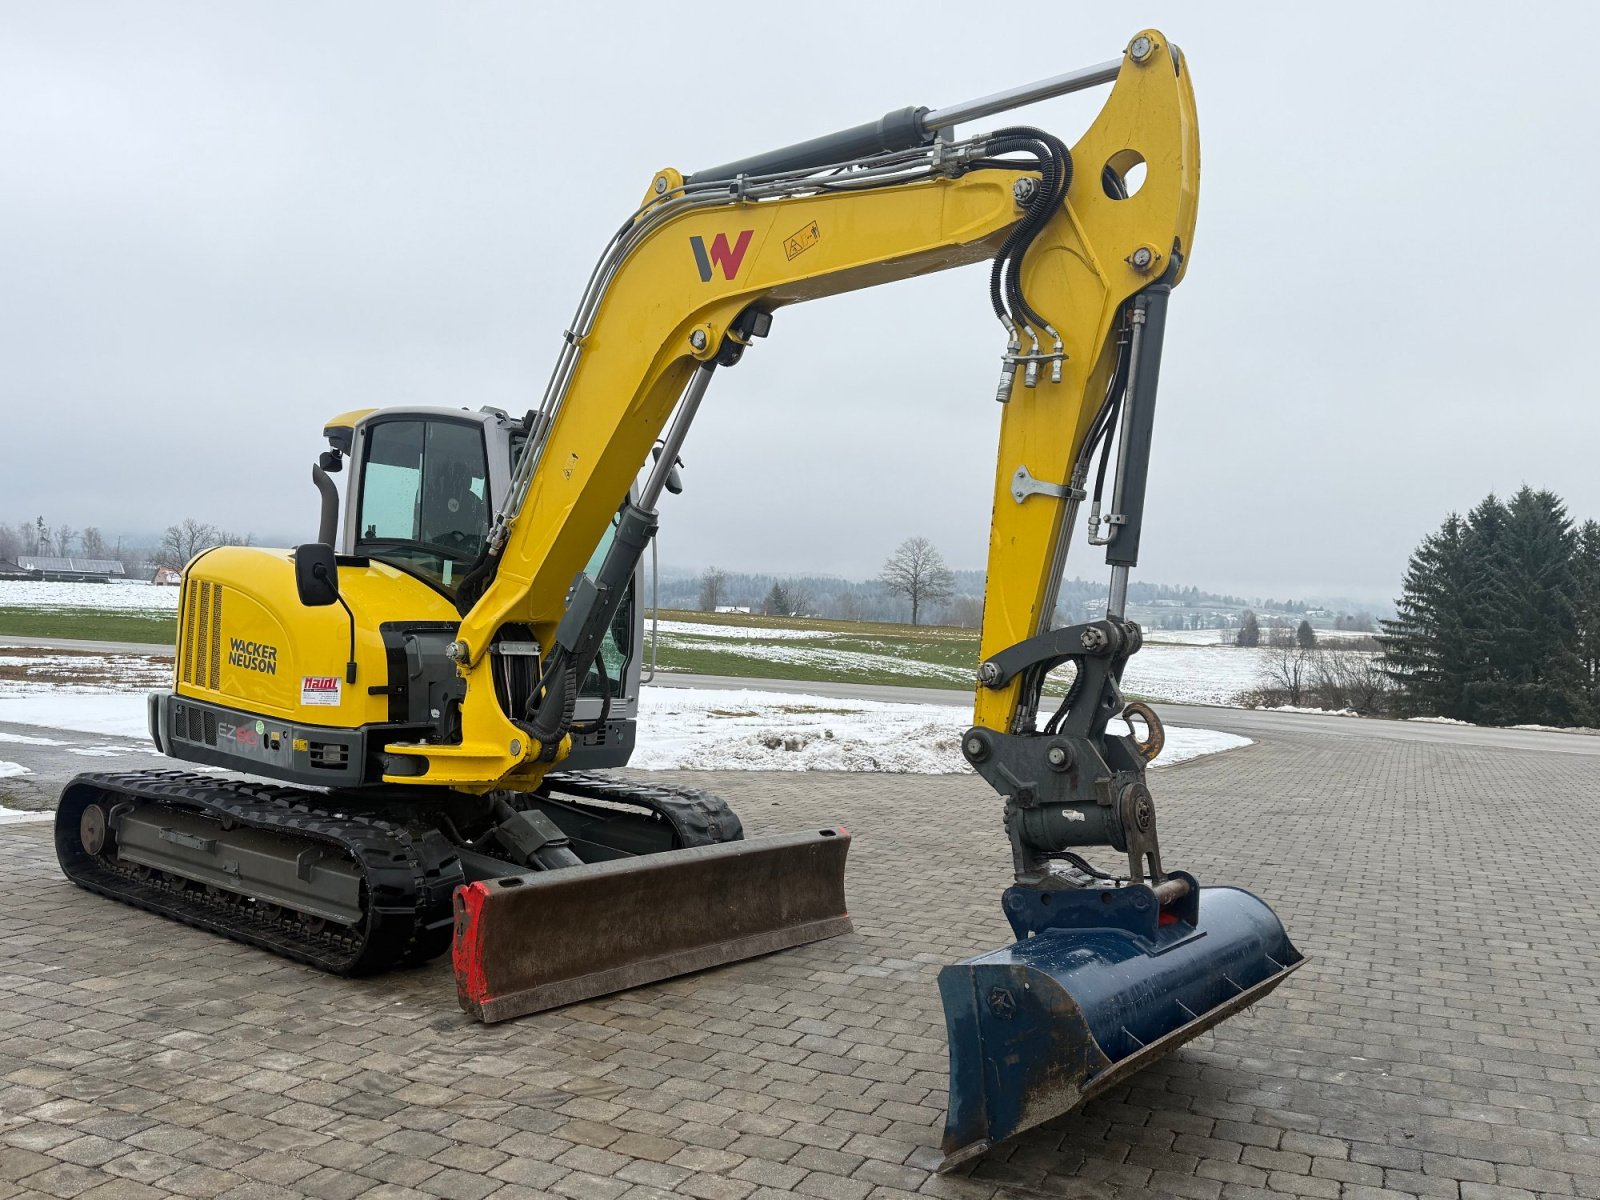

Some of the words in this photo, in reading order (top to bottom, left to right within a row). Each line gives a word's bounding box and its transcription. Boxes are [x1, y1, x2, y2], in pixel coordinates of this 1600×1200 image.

[230, 637, 277, 661] WACKER
[228, 651, 277, 675] NEUSON
[218, 722, 257, 746] EZ80
